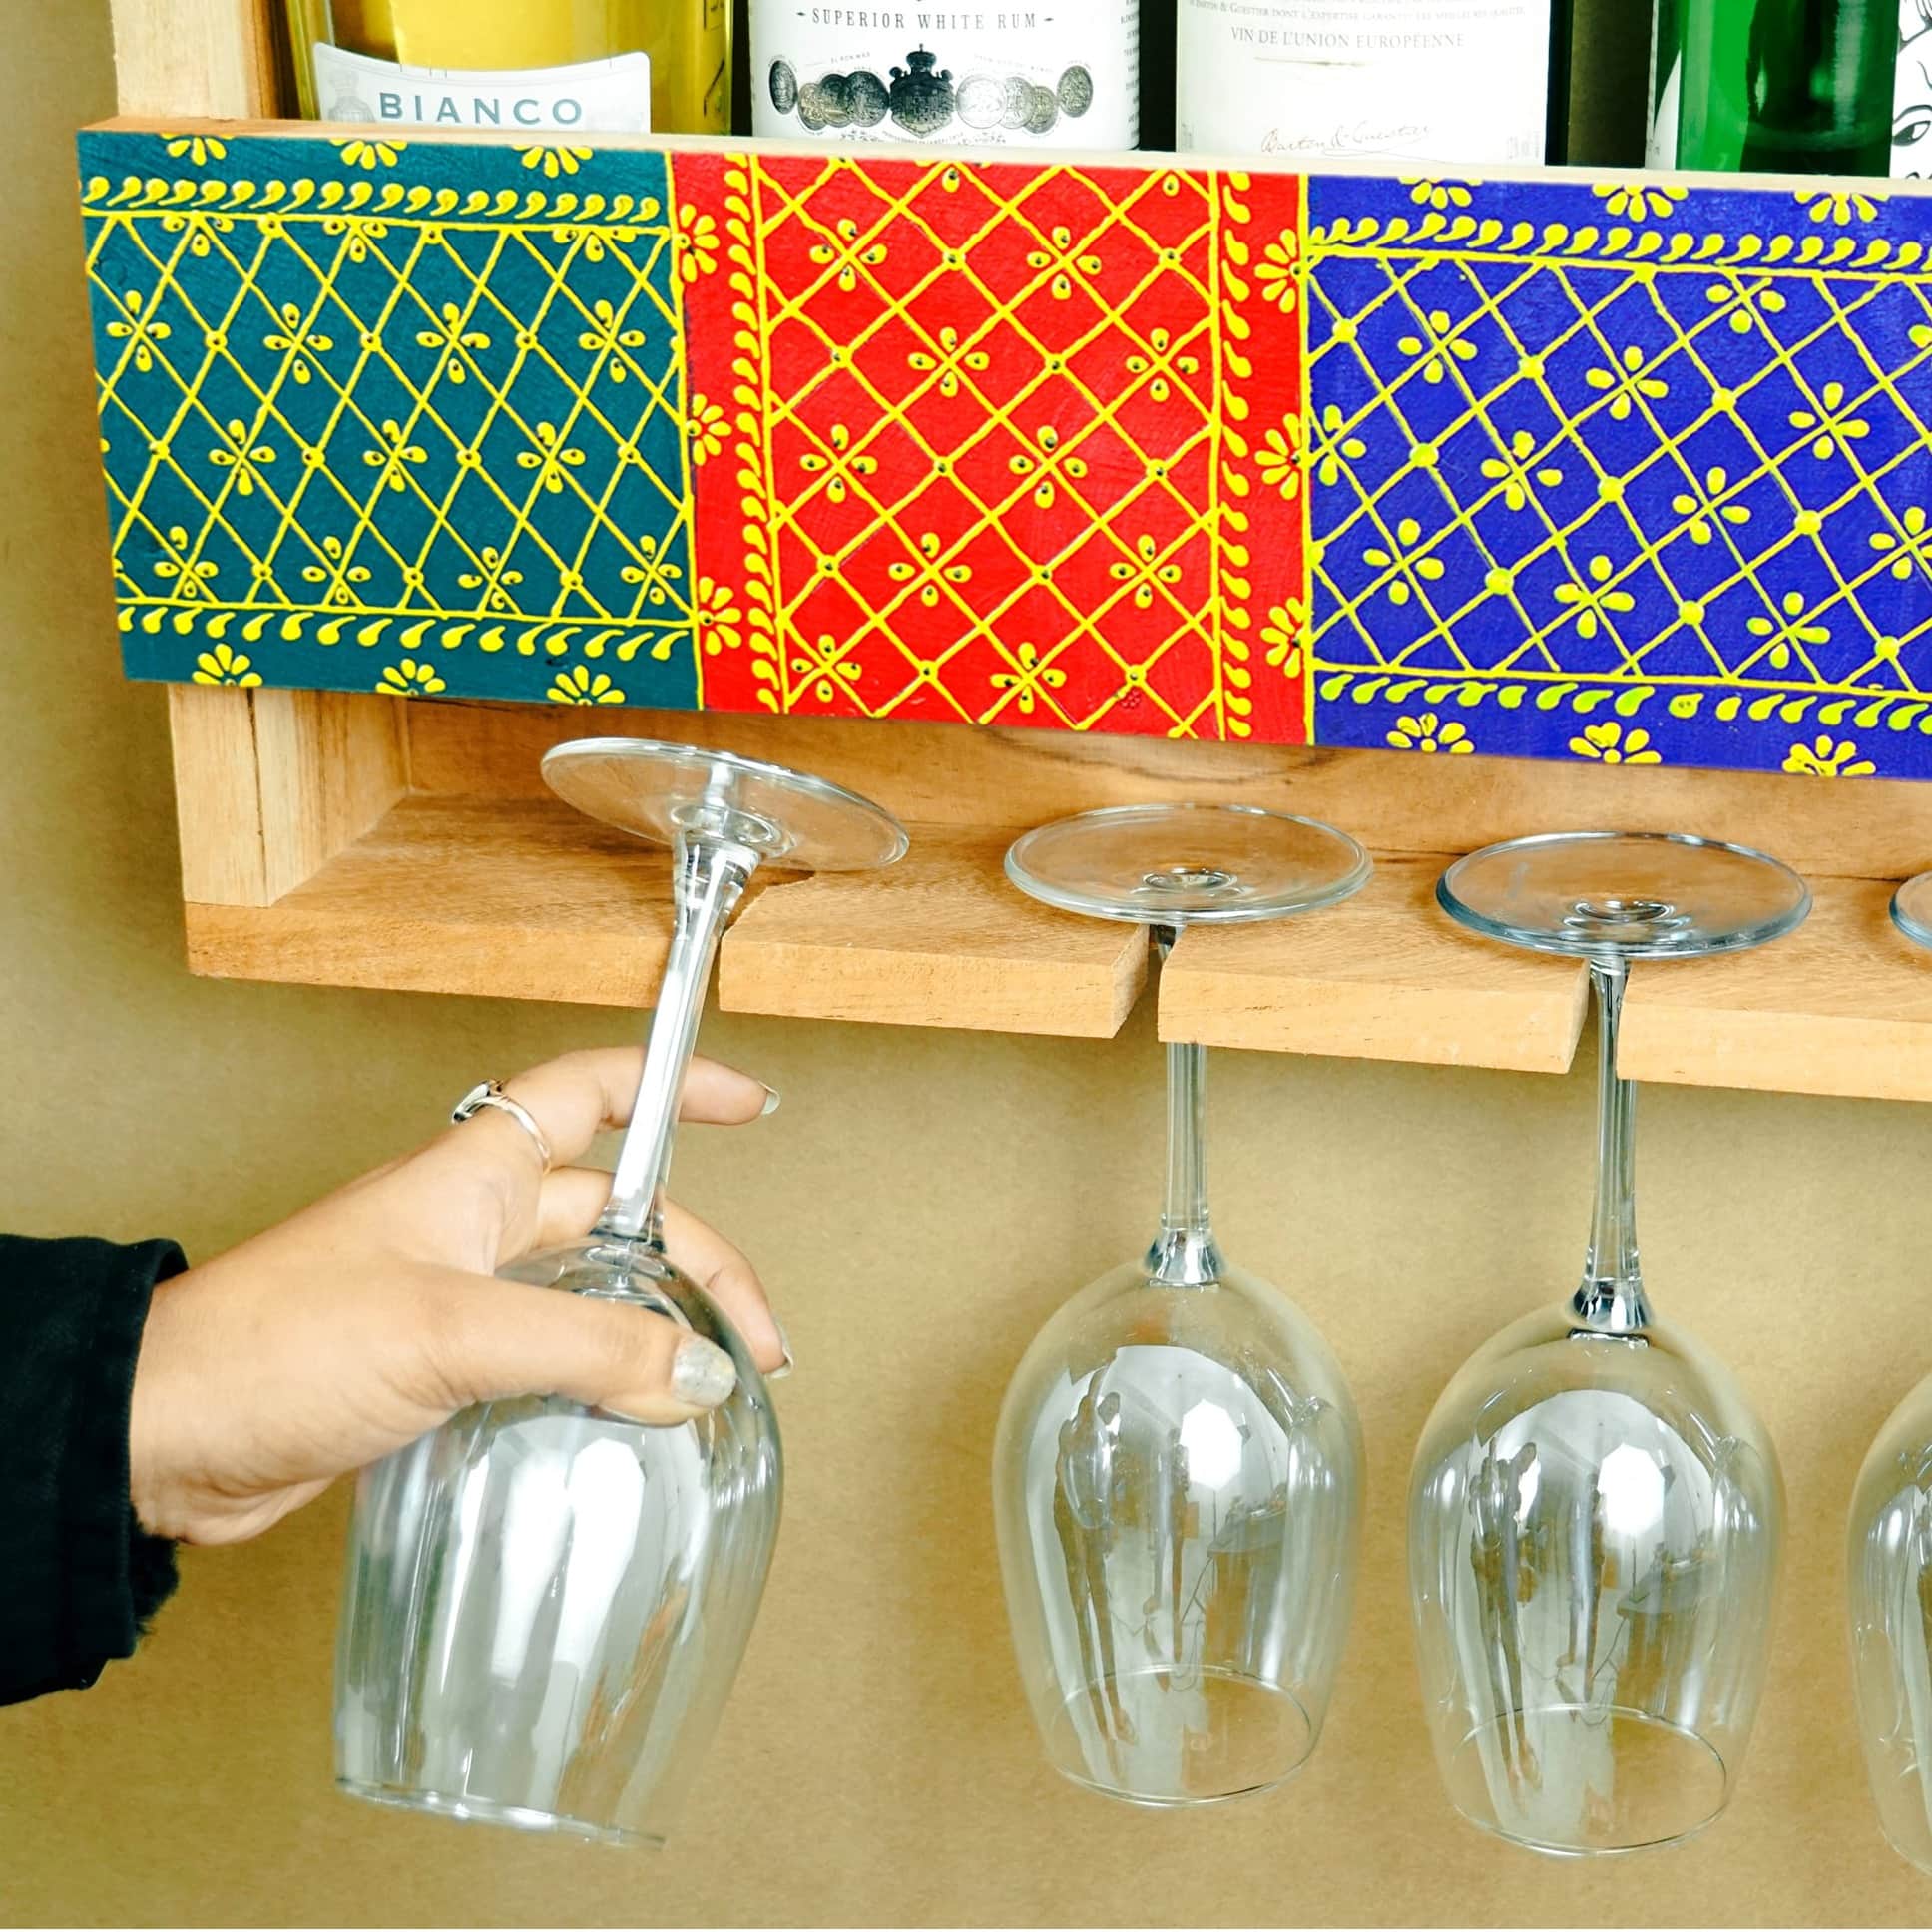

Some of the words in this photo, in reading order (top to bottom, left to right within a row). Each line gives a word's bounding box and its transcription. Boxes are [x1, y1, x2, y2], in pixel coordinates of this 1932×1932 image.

[812, 7, 905, 29] SUPERIOR
[918, 12, 985, 30] WHITE
[998, 12, 1037, 29] RUM
[1230, 26, 1254, 42] VIN
[1258, 30, 1279, 45] DE
[1283, 31, 1350, 48] L'UNION
[378, 91, 583, 125] BIANCO
